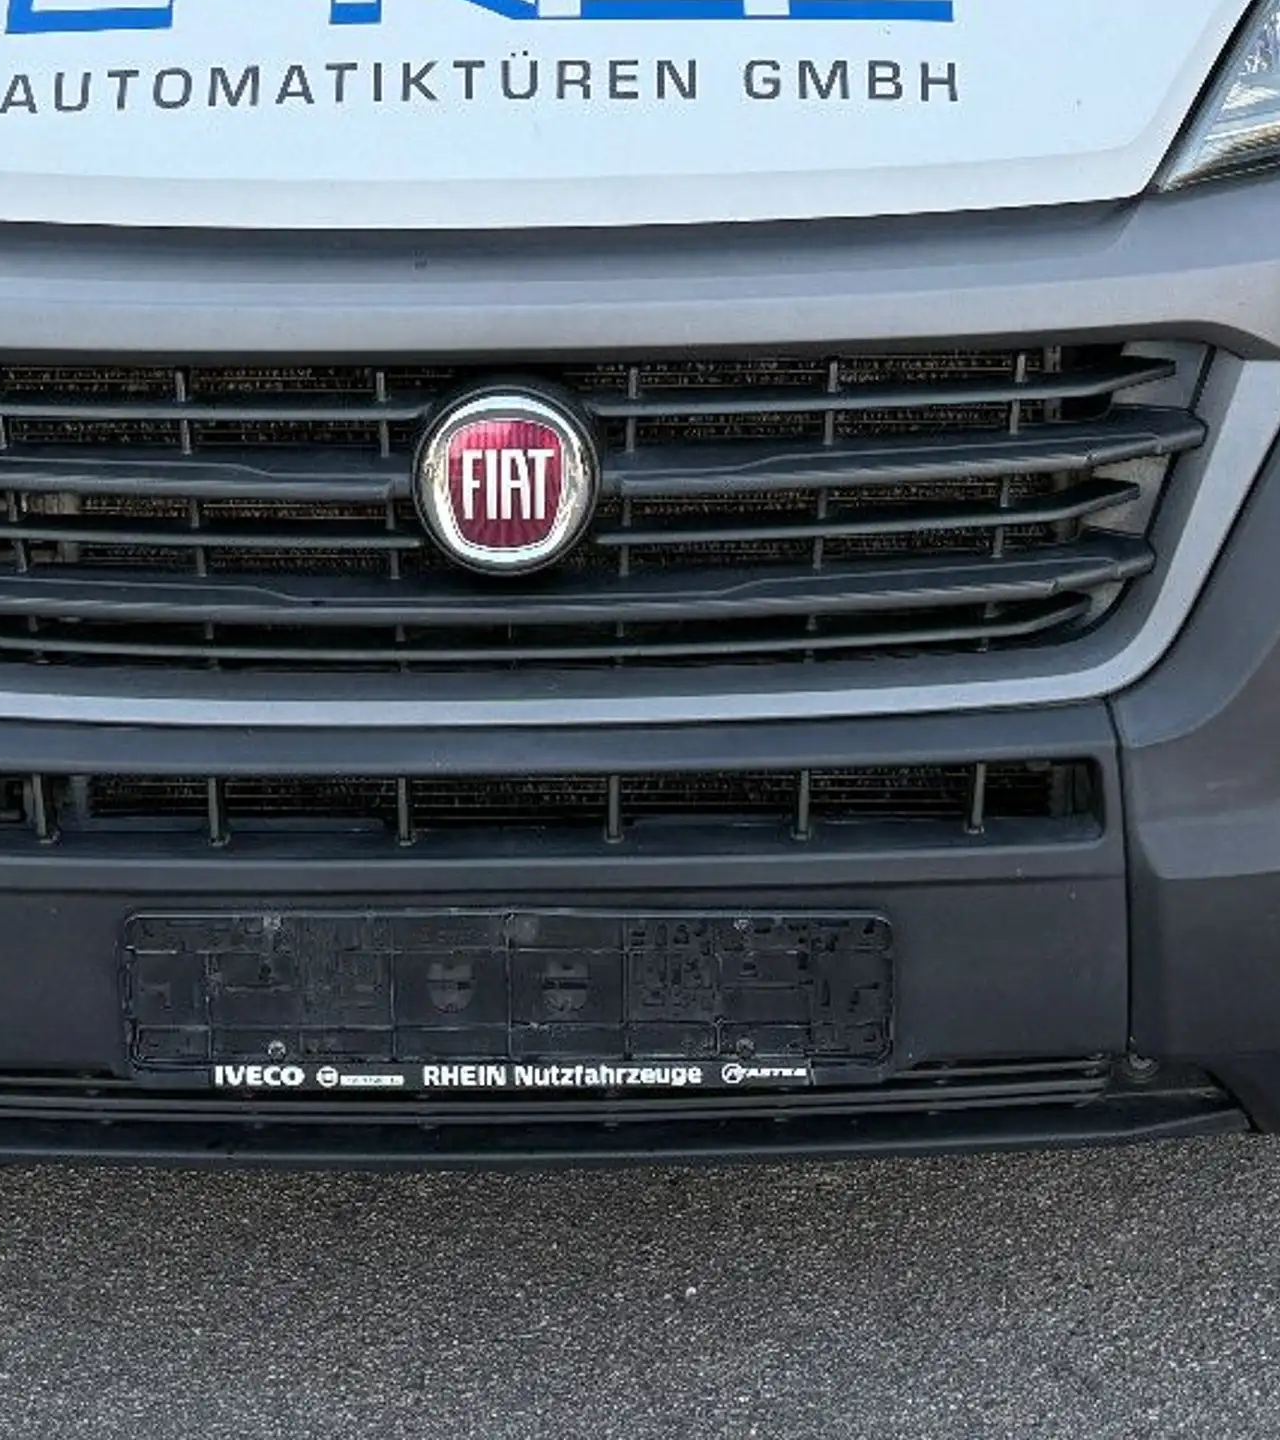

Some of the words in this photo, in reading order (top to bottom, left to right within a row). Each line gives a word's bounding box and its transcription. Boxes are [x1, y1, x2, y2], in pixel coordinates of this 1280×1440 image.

[743, 59, 960, 104] GMBH
[460, 447, 556, 521] FIAT
[214, 1065, 306, 1087] IVECO
[423, 1064, 507, 1087] RHEIN
[514, 1063, 702, 1087] Nutzfahrzeuge
